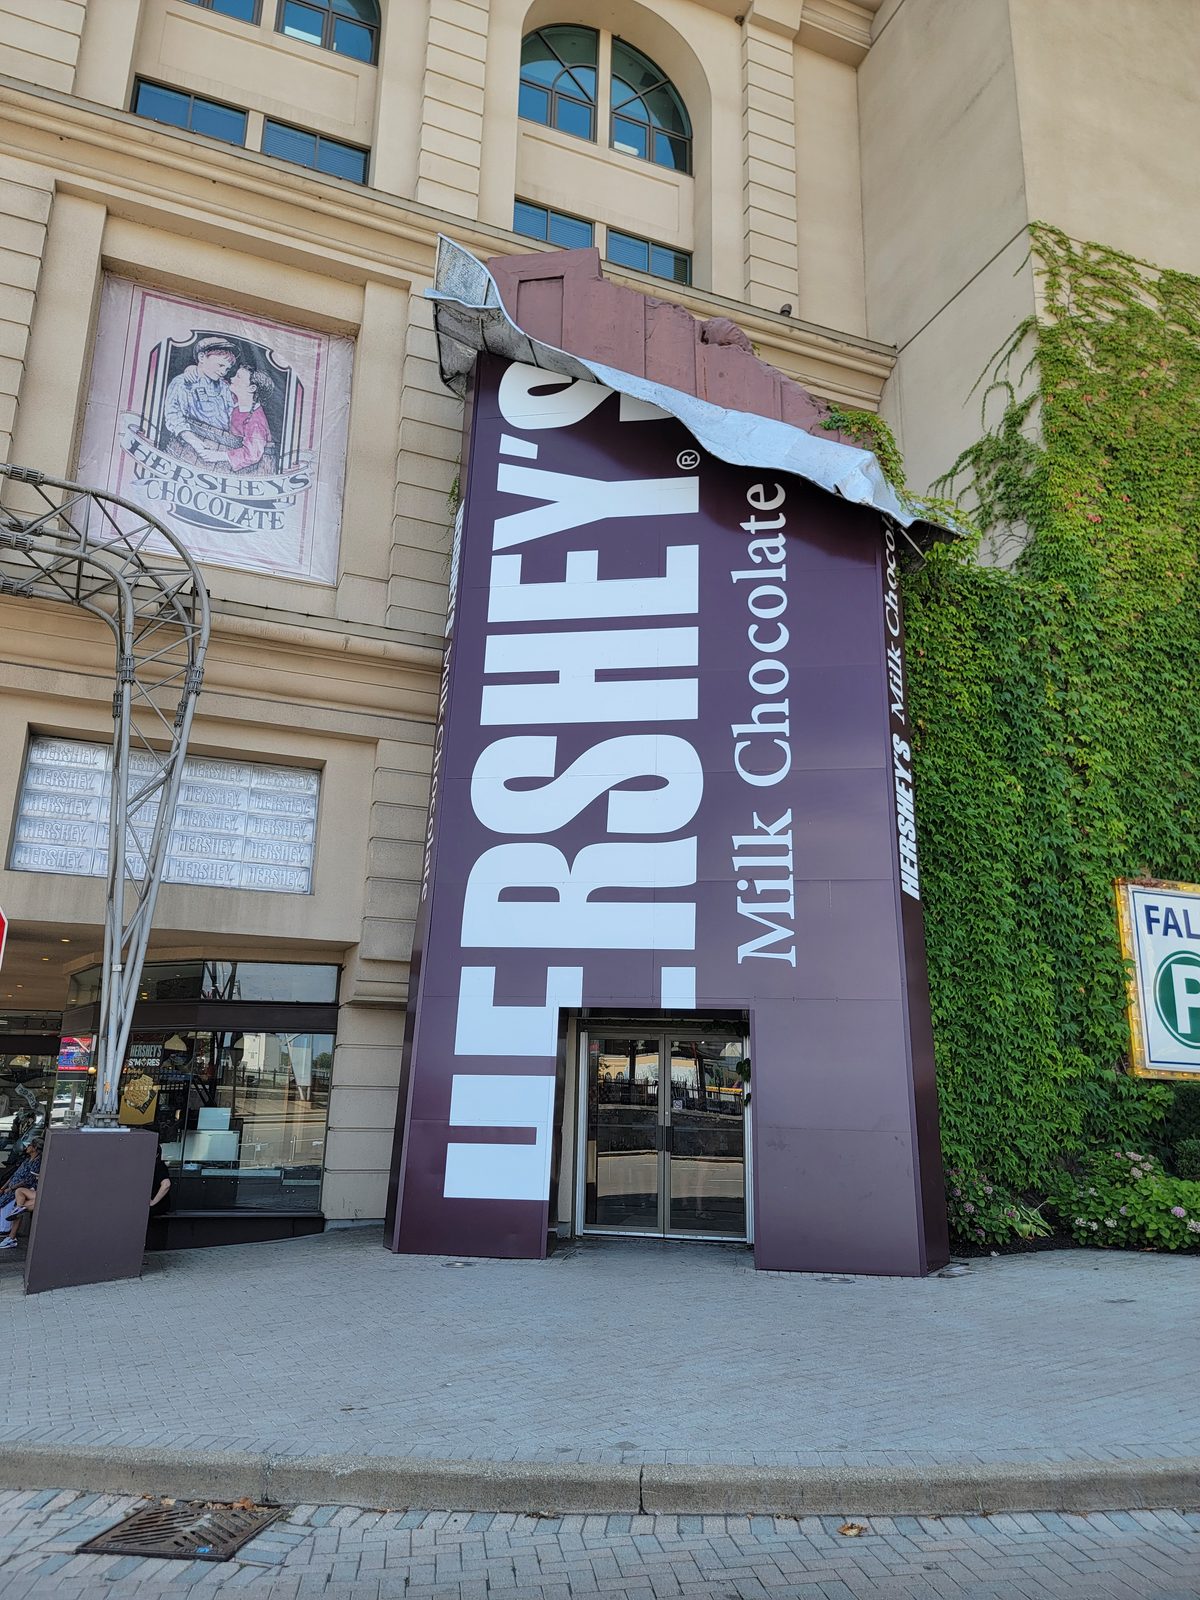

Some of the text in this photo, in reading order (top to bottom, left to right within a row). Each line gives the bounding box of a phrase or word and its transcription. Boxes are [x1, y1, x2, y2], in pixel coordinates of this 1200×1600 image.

[146, 479, 285, 530] CHOCOLATE
[438, 641, 453, 724] Milk
[730, 482, 797, 968] Milk Chocolate
[886, 640, 905, 726] Milk
[421, 724, 444, 903] Chocolate
[892, 732, 920, 900] HERSHEY'S
[130, 1044, 162, 1057] HERSHEY'S
